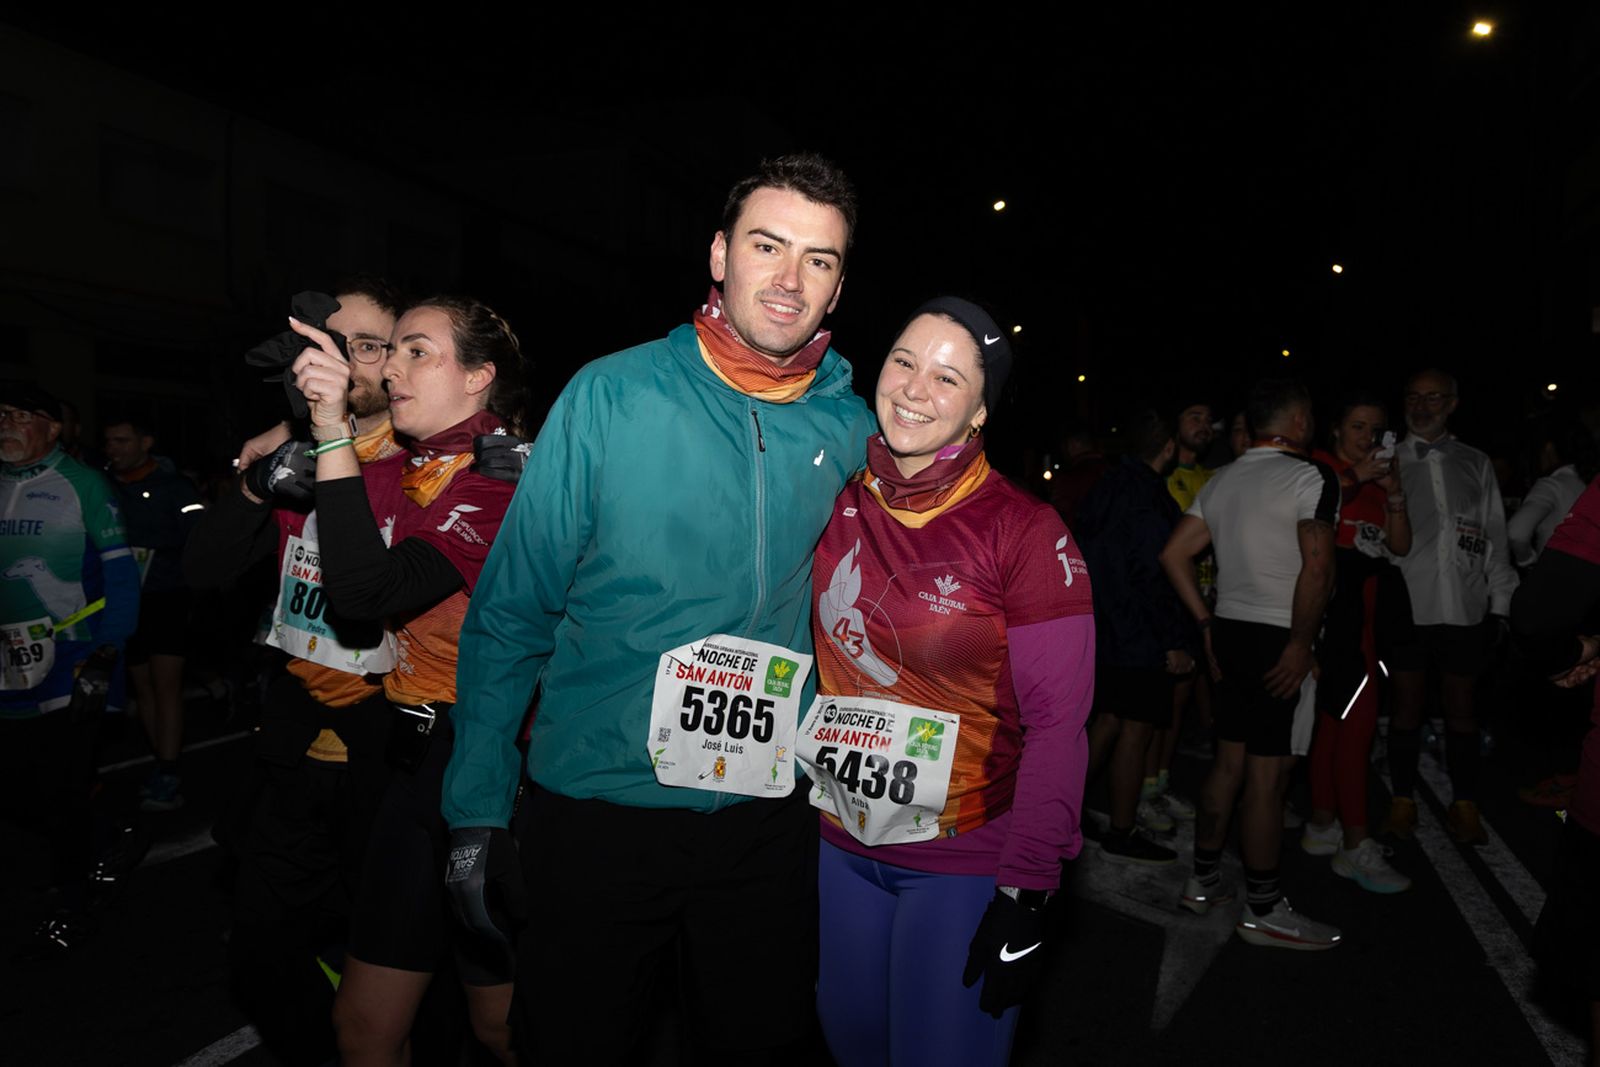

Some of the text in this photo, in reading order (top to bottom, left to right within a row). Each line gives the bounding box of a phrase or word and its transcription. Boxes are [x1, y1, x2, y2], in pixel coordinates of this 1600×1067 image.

[291, 565, 311, 580] SAN
[304, 554, 322, 568] NO
[938, 597, 967, 611] RURAL
[832, 616, 865, 659] 43
[697, 648, 758, 672] NOCHE DE
[676, 661, 753, 691] SAN ANTÓN
[680, 686, 775, 744] 5365
[835, 713, 895, 733] NOCHE DE
[702, 739, 744, 754] José Luis
[814, 727, 841, 743] SAN
[839, 730, 892, 751] ANTÓN
[816, 746, 918, 805] 5438
